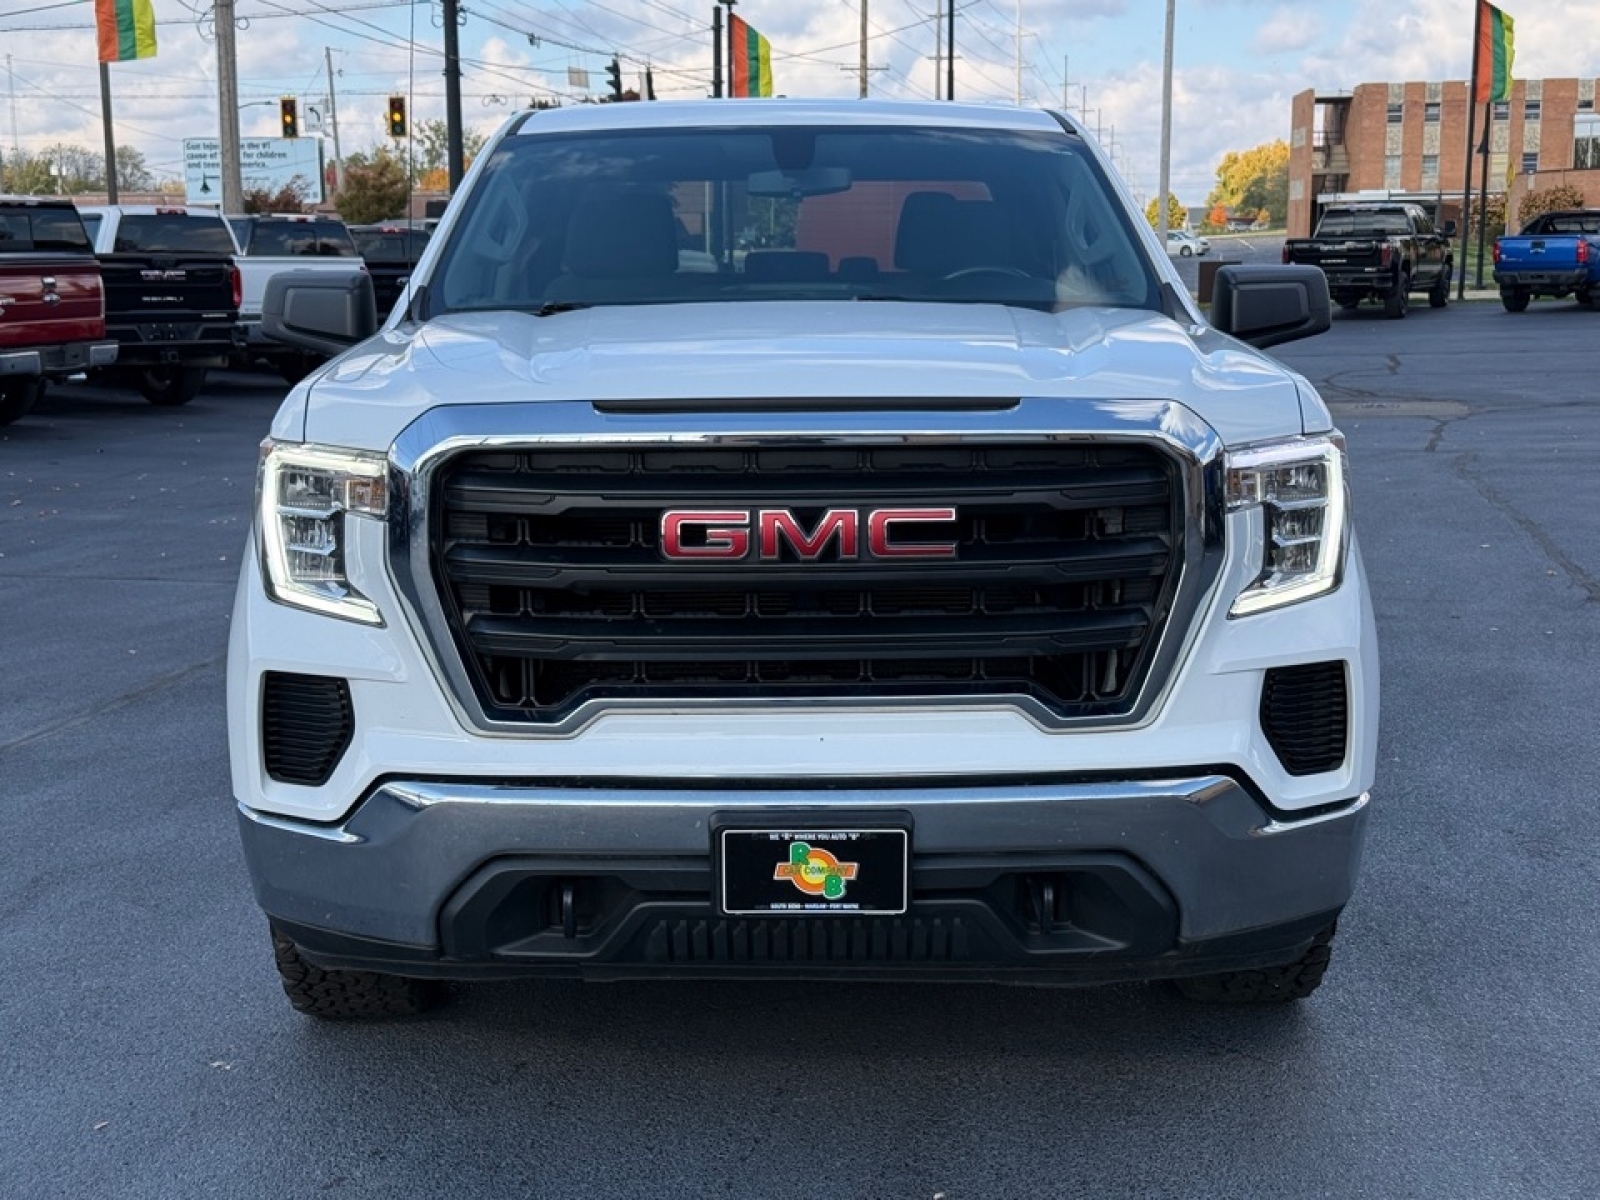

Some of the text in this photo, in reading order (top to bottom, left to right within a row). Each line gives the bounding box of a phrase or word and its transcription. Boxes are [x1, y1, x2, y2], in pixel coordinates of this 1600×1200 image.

[247, 141, 260, 150] the
[186, 151, 287, 160] cause of for children
[203, 161, 220, 169] teen
[661, 508, 956, 560] GMC
[769, 833, 780, 841] WE
[794, 833, 817, 841] WHERE
[817, 833, 830, 841] YOU
[831, 833, 848, 841] AUTO
[789, 841, 811, 865] R
[823, 875, 846, 899] B
[769, 902, 787, 910] SOUTH
